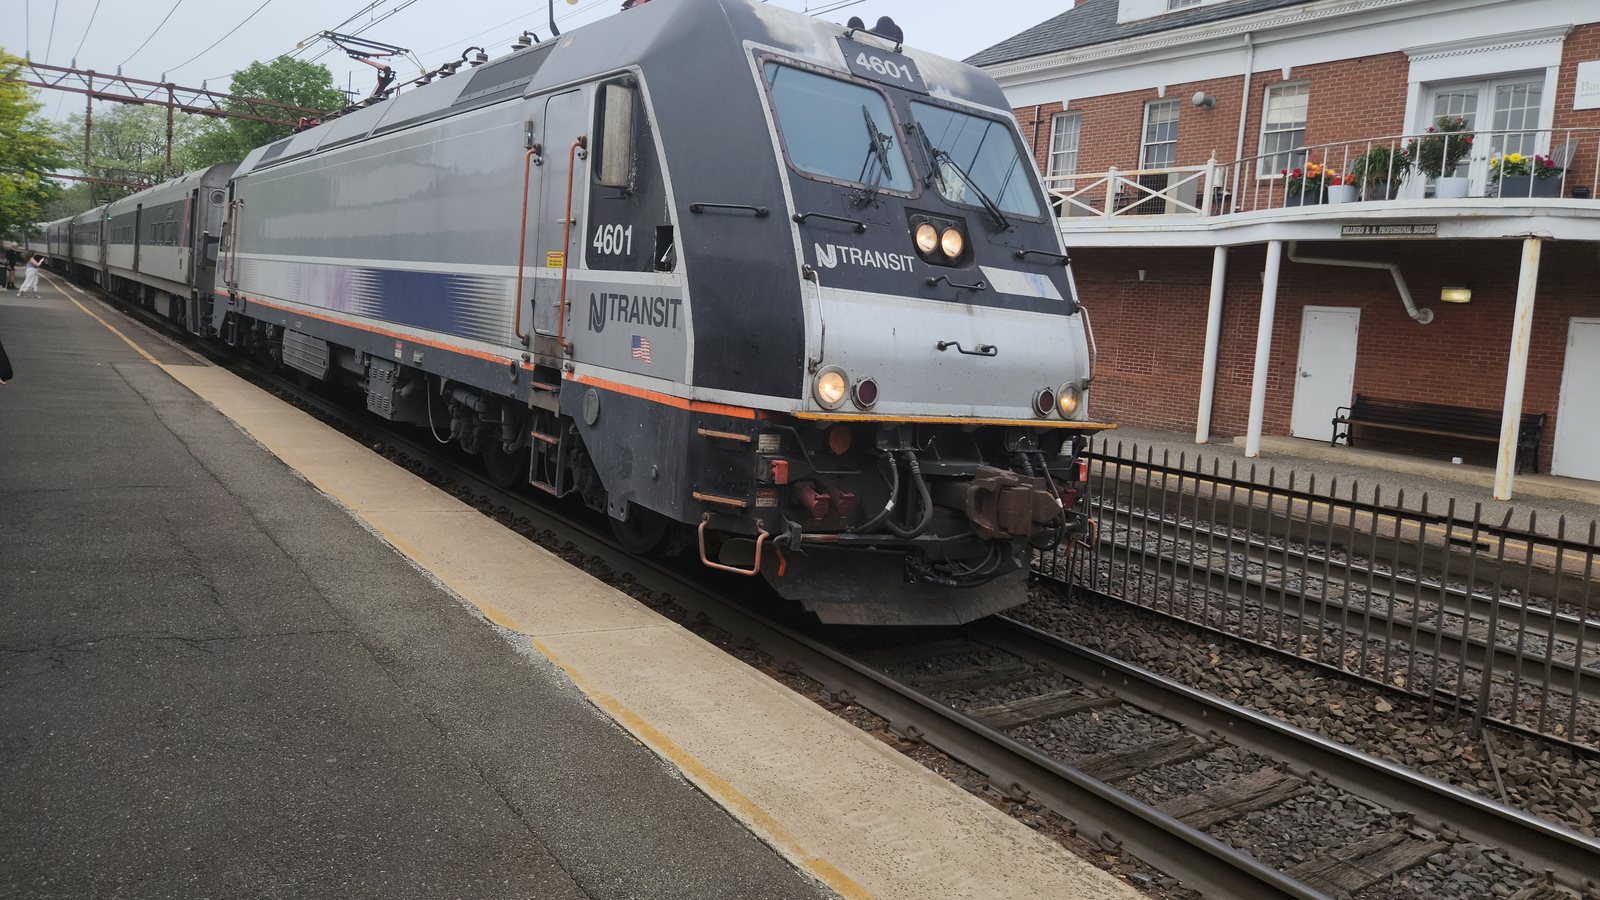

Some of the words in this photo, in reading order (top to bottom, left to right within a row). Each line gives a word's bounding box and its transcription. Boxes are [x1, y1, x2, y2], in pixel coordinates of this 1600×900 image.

[856, 53, 913, 82] 4601
[593, 224, 632, 255] 4601
[1378, 225, 1412, 234] PROFESSIONAL
[1413, 225, 1436, 233] BUILDING
[836, 245, 915, 272] TRANSIT
[608, 293, 682, 329] TRANSIT
